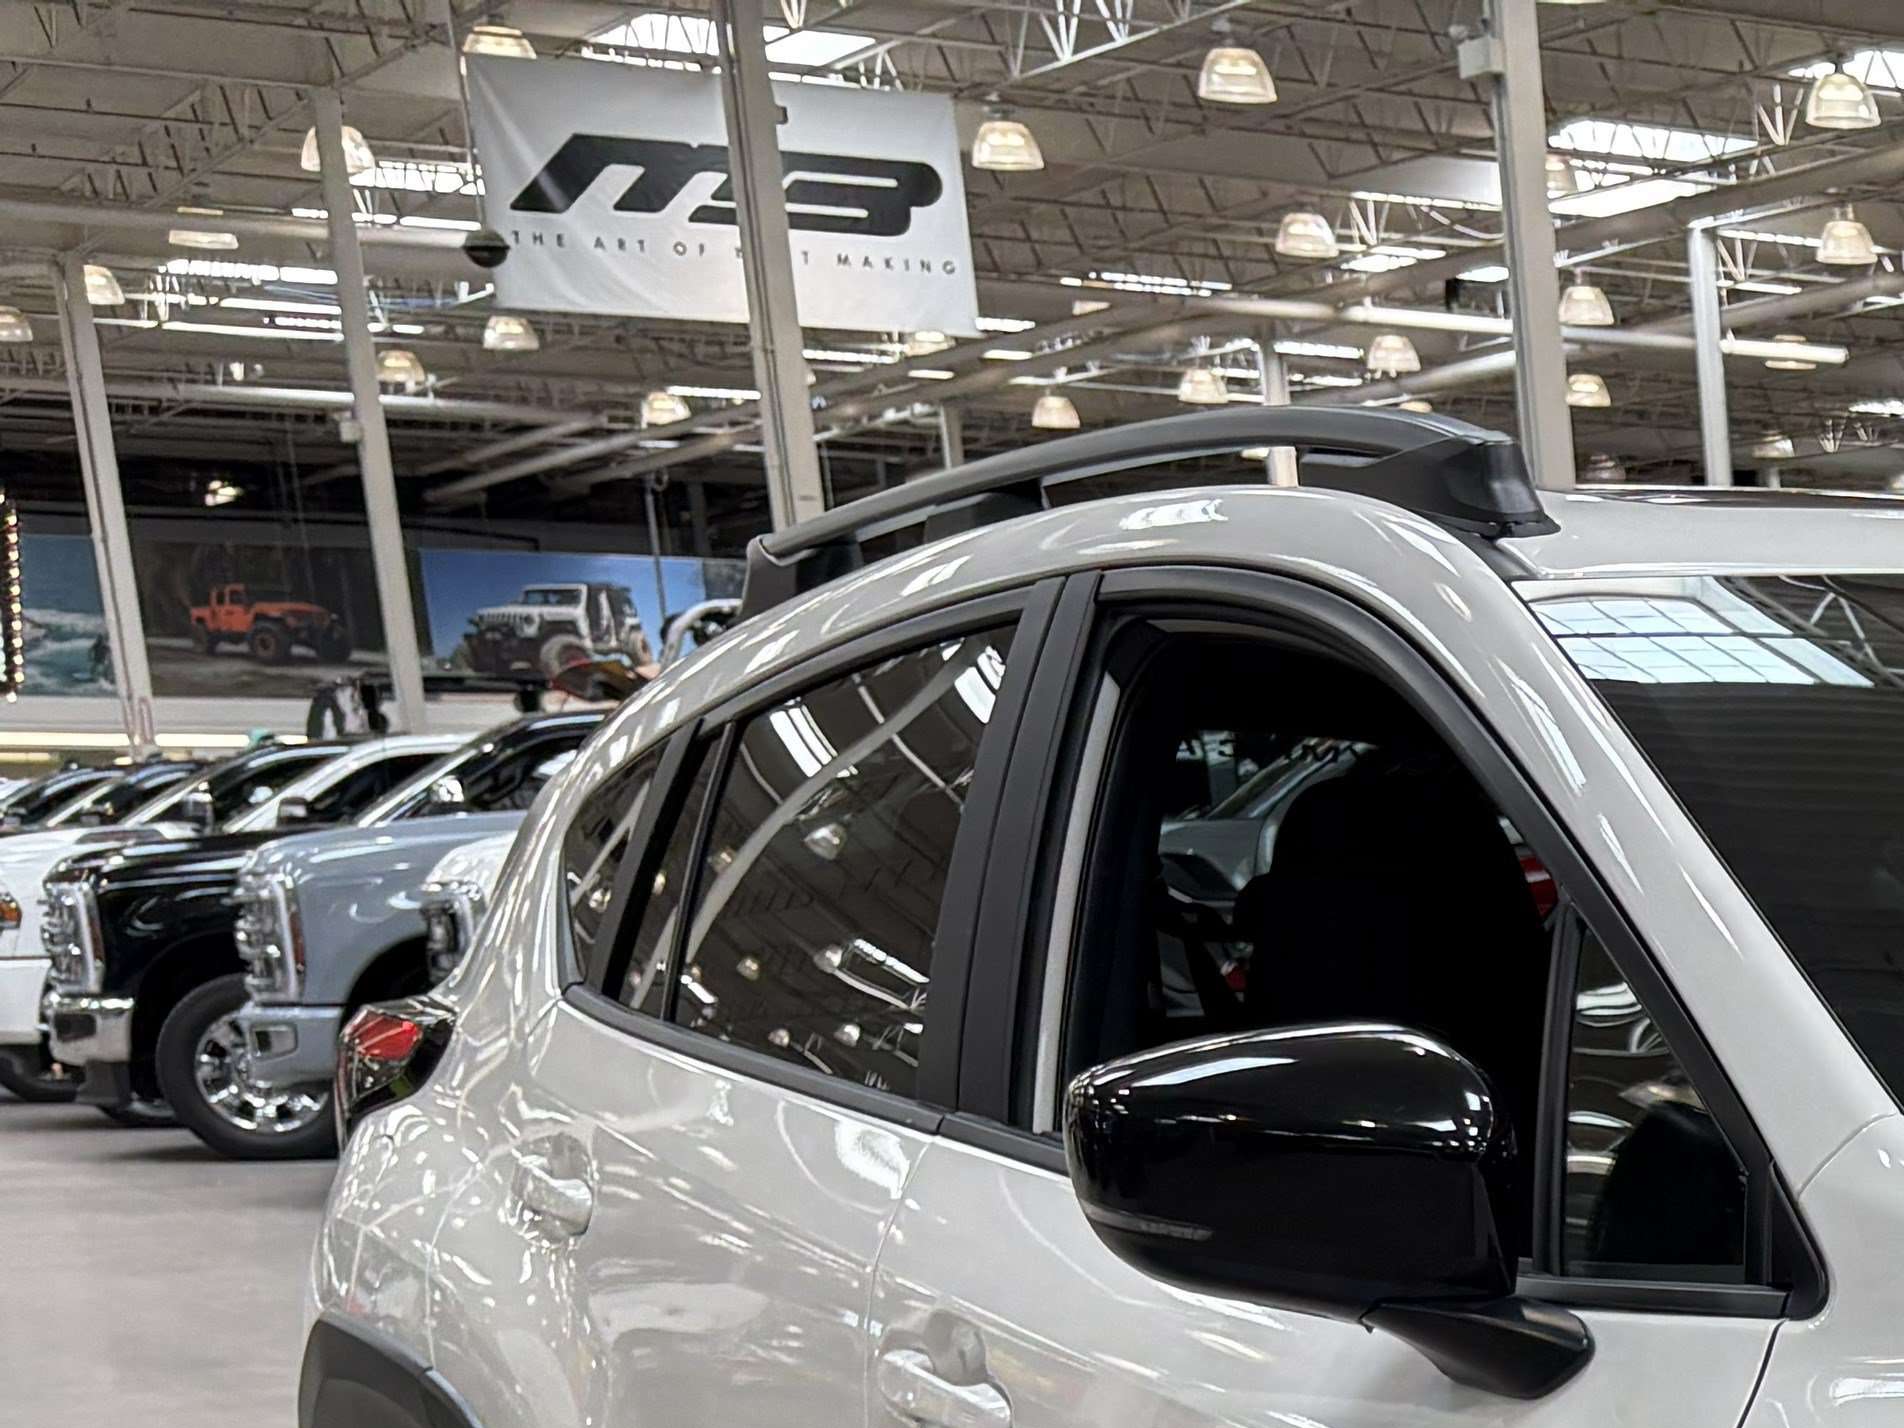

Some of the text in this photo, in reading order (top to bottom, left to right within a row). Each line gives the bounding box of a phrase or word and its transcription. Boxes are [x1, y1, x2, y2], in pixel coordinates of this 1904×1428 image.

[511, 230, 957, 275] THE ART OF MAKING
